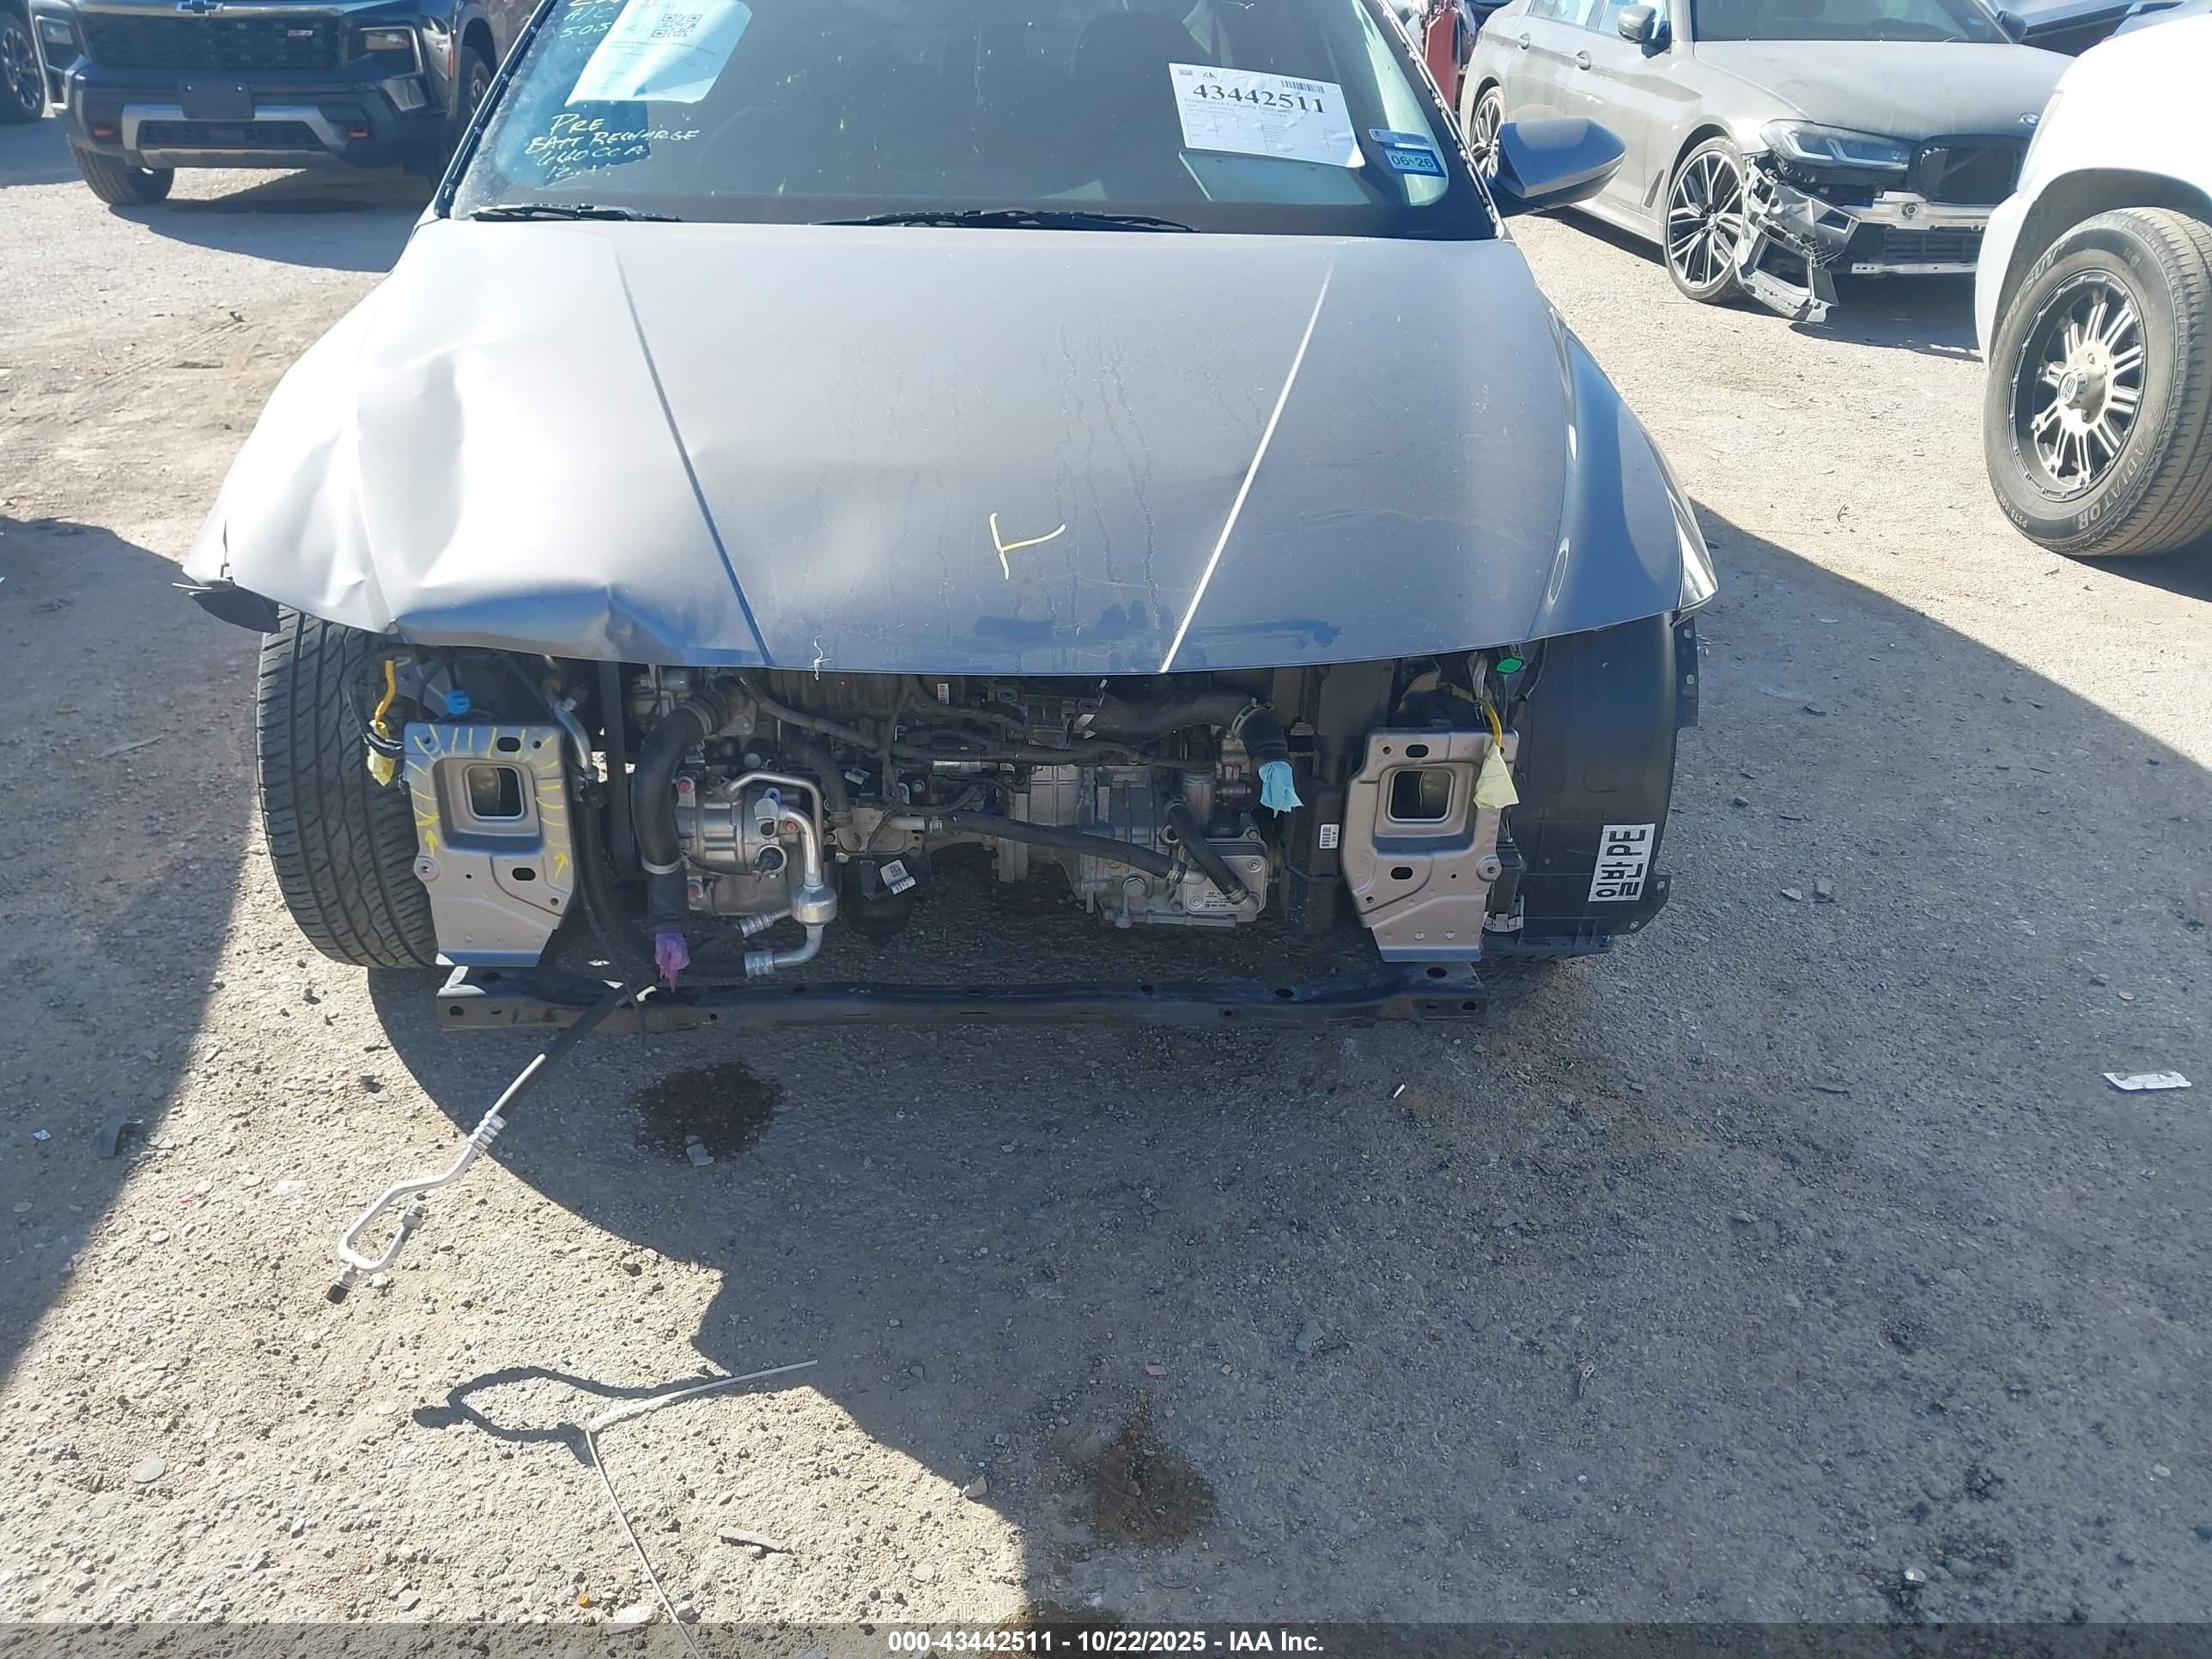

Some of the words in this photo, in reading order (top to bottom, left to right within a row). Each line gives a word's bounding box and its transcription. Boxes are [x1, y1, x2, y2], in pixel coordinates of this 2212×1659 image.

[1193, 84, 1326, 113] 43442511
[550, 112, 605, 137] PRE
[1606, 829, 1646, 856] PE
[1595, 861, 1644, 897] 일반
